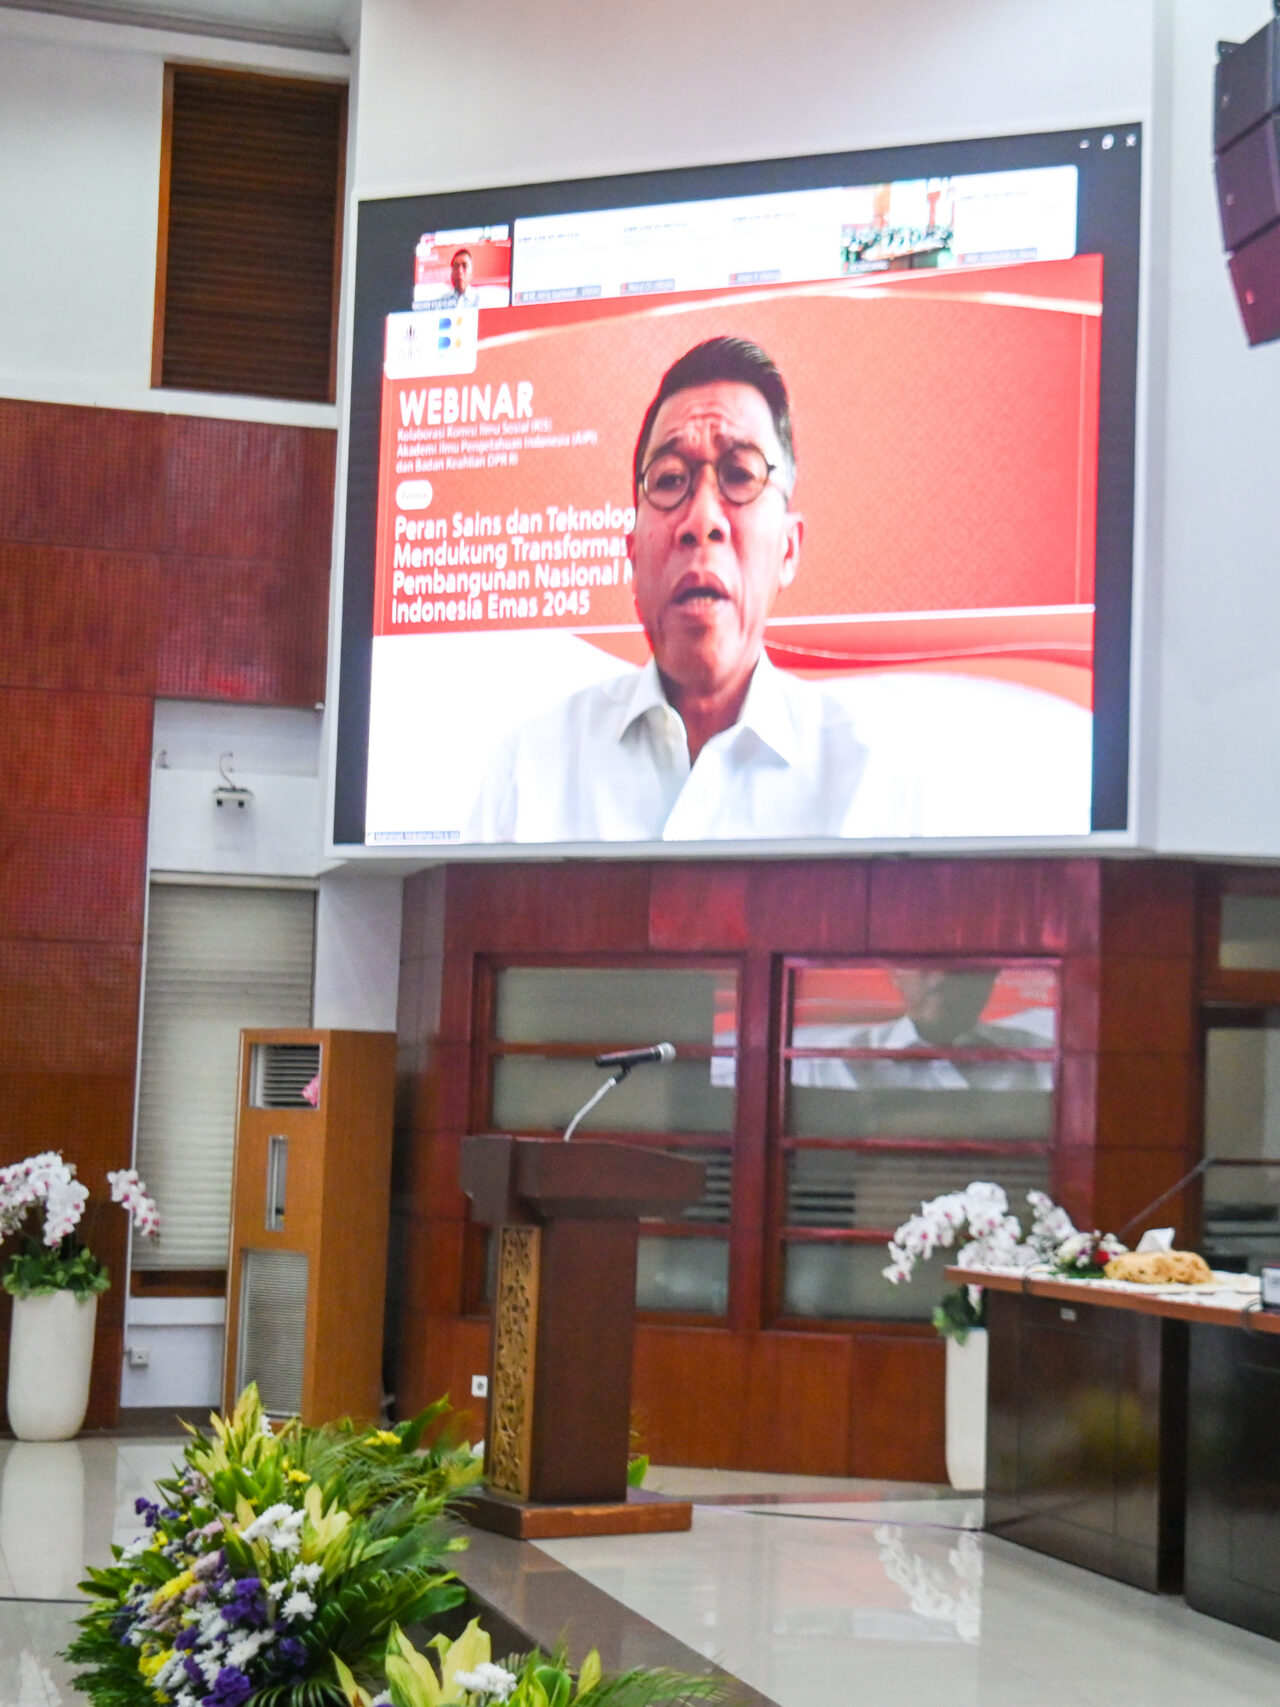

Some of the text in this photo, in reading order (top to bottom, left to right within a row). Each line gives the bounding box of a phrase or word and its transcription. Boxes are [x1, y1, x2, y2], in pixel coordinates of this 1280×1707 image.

[399, 381, 534, 427] WEBINAR
[396, 442, 437, 459] Akademi
[524, 433, 570, 449] Indonesia
[397, 427, 445, 443] Kolaborasi
[396, 459, 413, 474] dan
[415, 456, 444, 472] Badan
[395, 502, 637, 541] Peran Sains dan Teknolog
[393, 533, 629, 569] Mendukung Transformas
[393, 566, 530, 598] Pembangunan
[534, 558, 618, 588] Nasional
[391, 589, 590, 624] Indonesia Emas 2045
